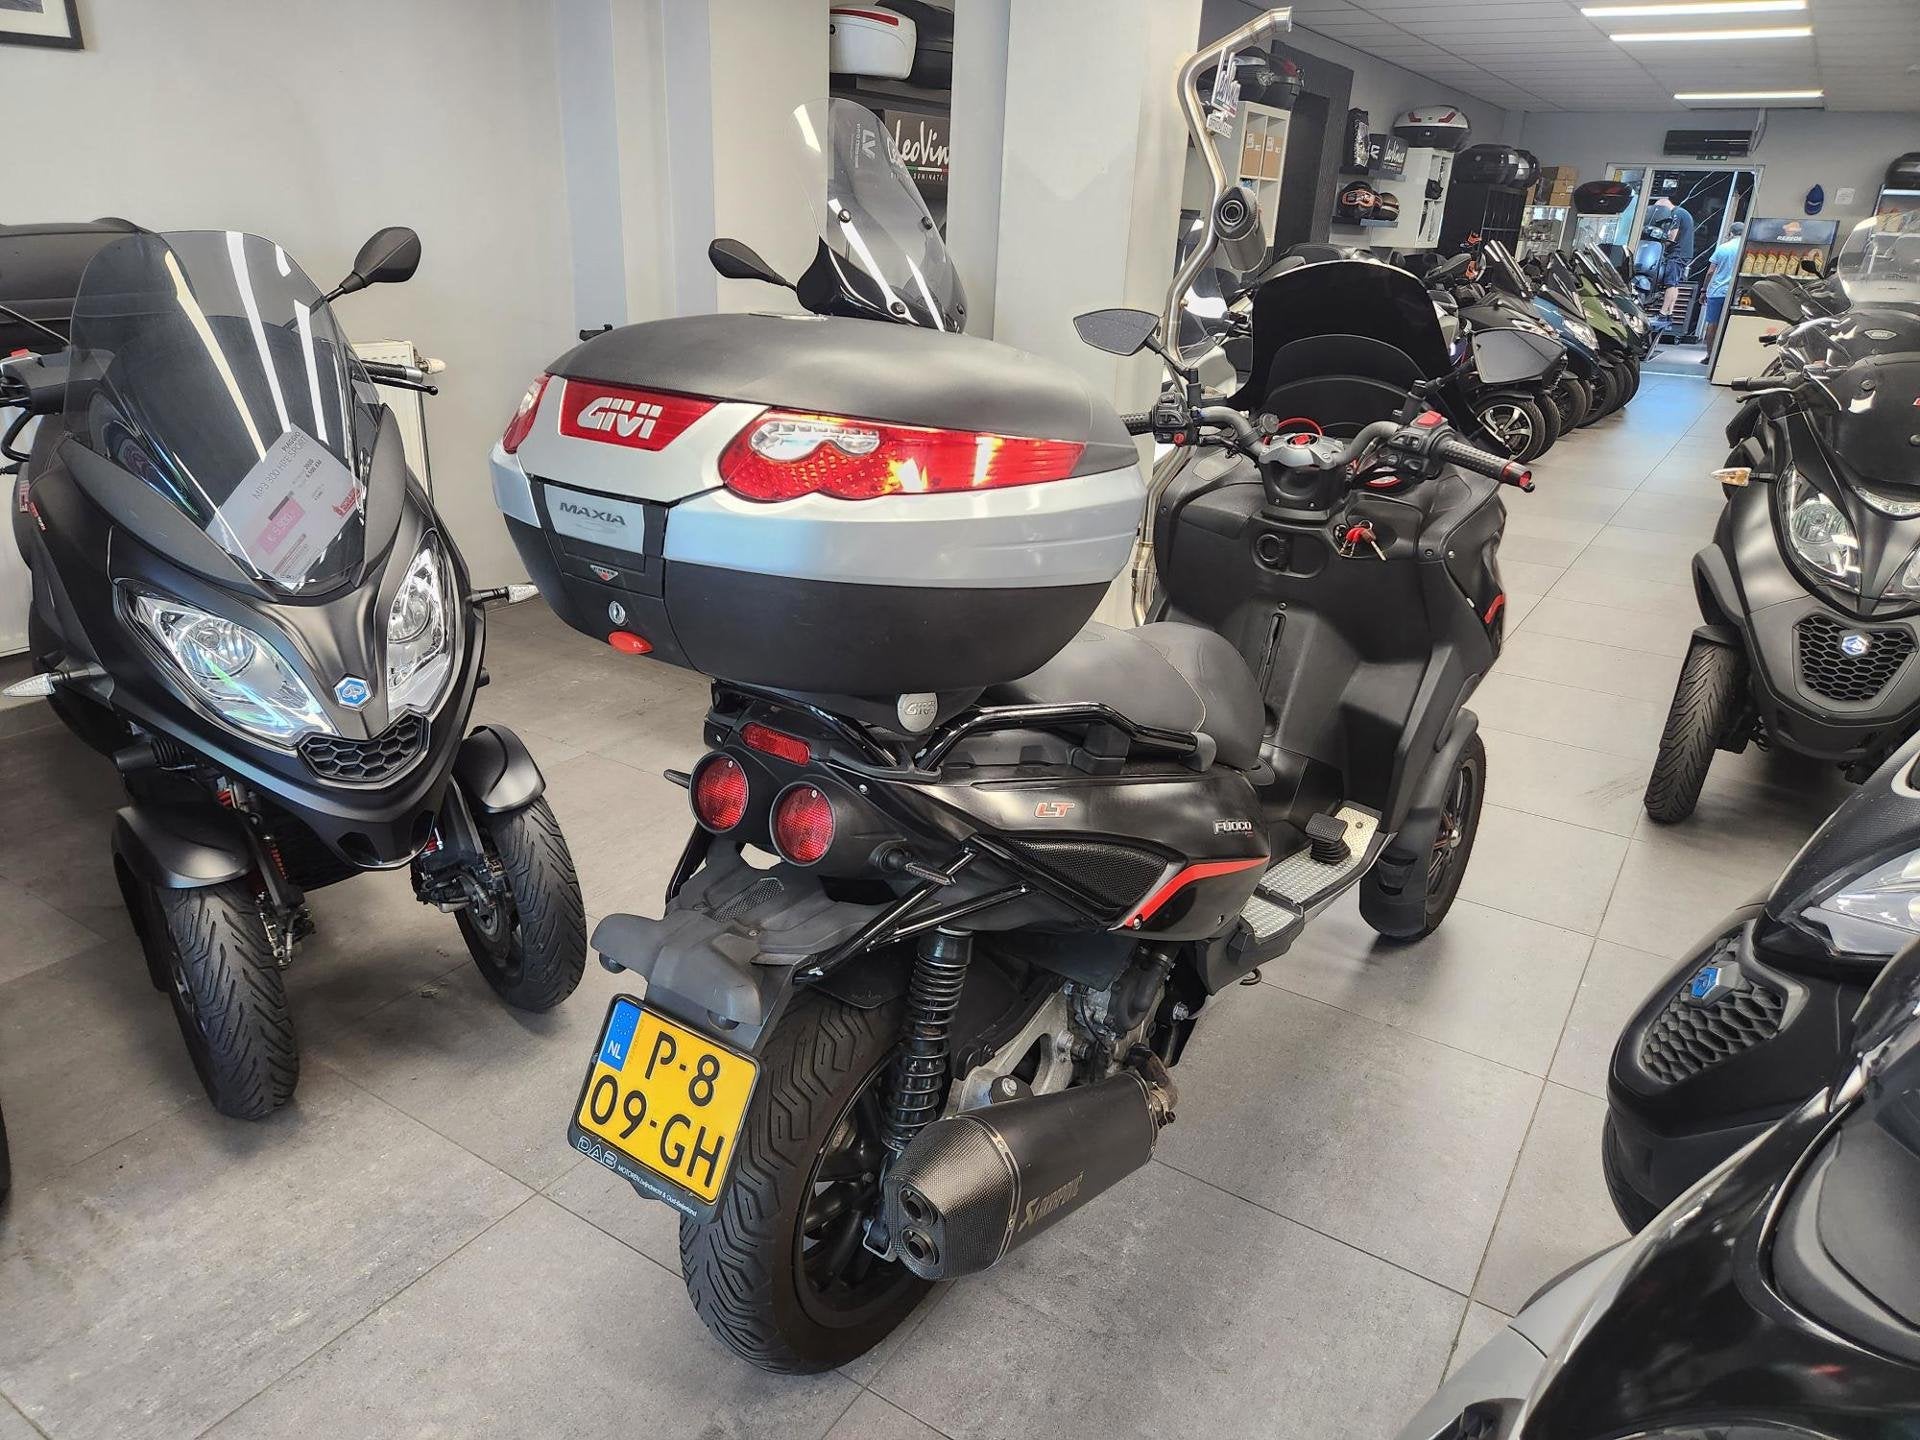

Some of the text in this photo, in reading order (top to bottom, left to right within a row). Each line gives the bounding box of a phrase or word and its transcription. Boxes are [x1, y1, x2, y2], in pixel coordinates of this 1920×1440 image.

[559, 502, 627, 526] MAXIA
[1034, 802, 1075, 818] LT
[1213, 821, 1253, 834] FUOCO
[607, 1040, 622, 1060] NL
[644, 1030, 721, 1107] P-8
[590, 1074, 725, 1188] 09-GH
[577, 1135, 618, 1169] DAB
